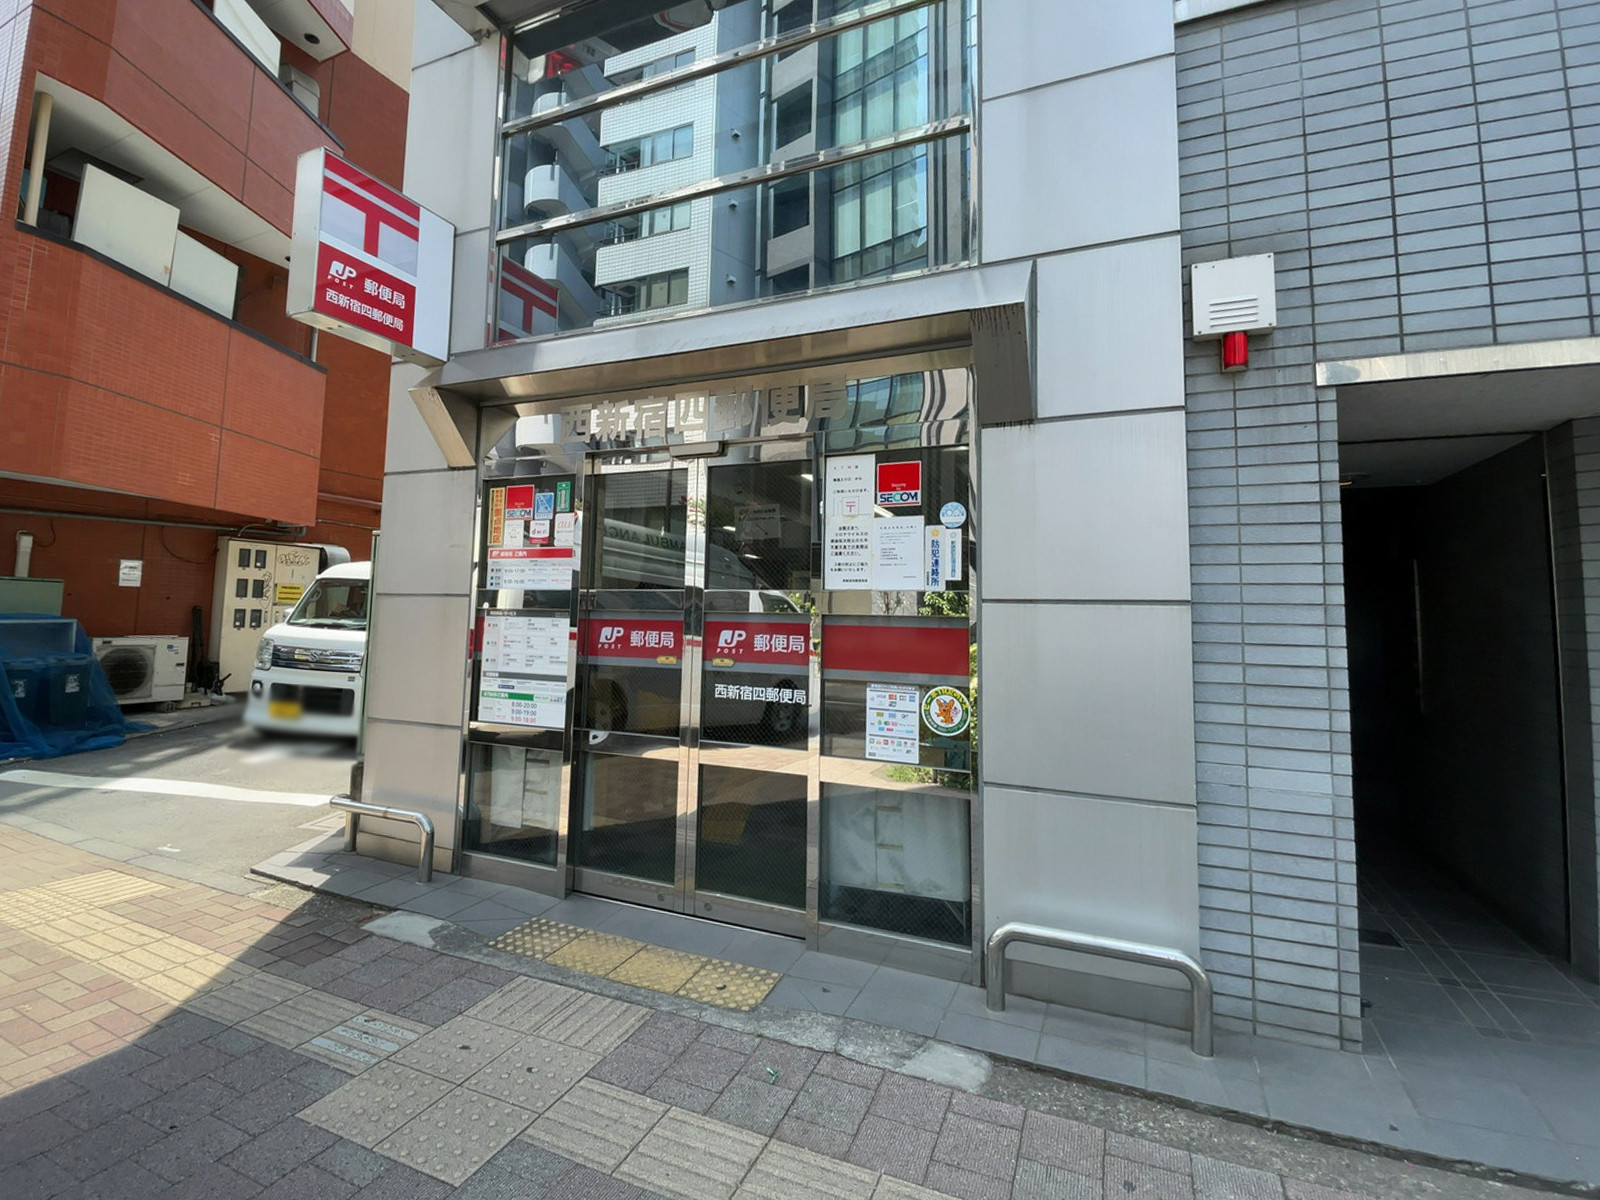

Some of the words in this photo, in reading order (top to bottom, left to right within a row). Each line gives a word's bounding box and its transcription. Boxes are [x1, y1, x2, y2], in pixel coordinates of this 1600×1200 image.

[326, 274, 354, 290] POST
[364, 278, 406, 309] 郵便局
[326, 288, 404, 332] 西新宿四郵便局
[561, 378, 848, 444] 西新宿四郵便局
[880, 492, 918, 503] SECOM
[507, 510, 532, 518] SECOM
[930, 540, 940, 587] 防犯連絡所
[630, 630, 674, 649] 郵便局
[753, 634, 805, 654] 郵便局
[714, 683, 807, 704] 西新宿四郵便局
